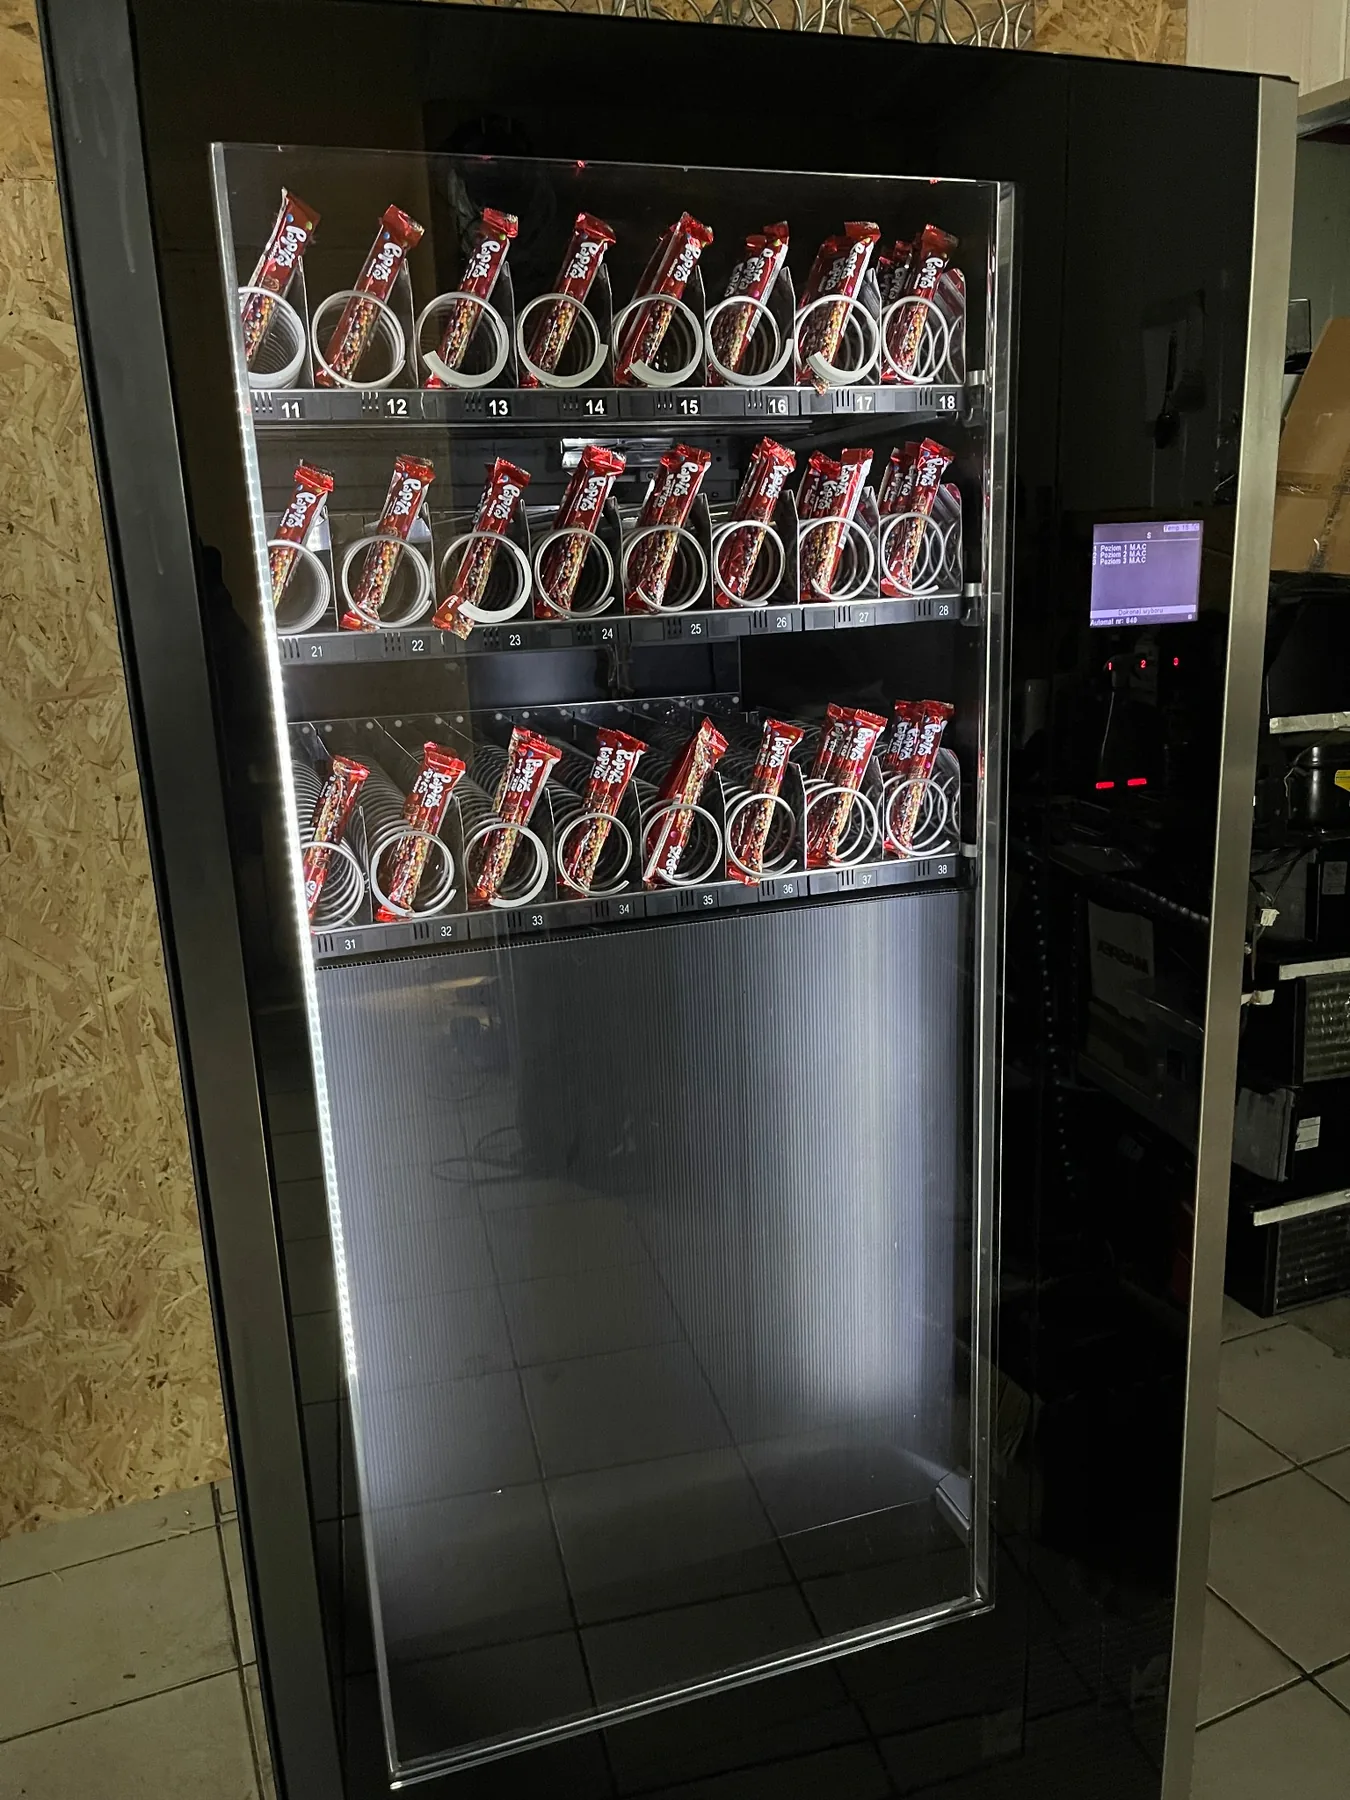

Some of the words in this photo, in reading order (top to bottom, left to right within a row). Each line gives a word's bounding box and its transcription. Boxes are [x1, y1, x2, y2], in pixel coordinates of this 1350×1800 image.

[387, 399, 408, 415] 12
[489, 400, 509, 415] 13
[585, 399, 605, 415] 14
[680, 400, 699, 415] 15
[769, 397, 786, 413] 16
[856, 396, 873, 411] 17
[939, 395, 956, 410] 18
[281, 401, 300, 418] 11
[938, 605, 950, 616] 28
[776, 616, 788, 628] 26
[858, 611, 869, 623] 27
[602, 628, 613, 640] 24
[690, 623, 702, 635] 25
[411, 639, 424, 652] 22
[509, 634, 521, 646] 23
[311, 645, 323, 658] 21
[1107, 662, 1112, 671] 1
[1140, 659, 1146, 668] 2
[1173, 657, 1179, 666] 3
[937, 864, 948, 875] 38
[861, 873, 872, 885] 37
[782, 883, 793, 894] 36
[702, 894, 713, 906] 35
[619, 903, 630, 915] 34
[531, 914, 543, 926] 33
[440, 925, 452, 937] 32
[344, 938, 356, 950] 31
